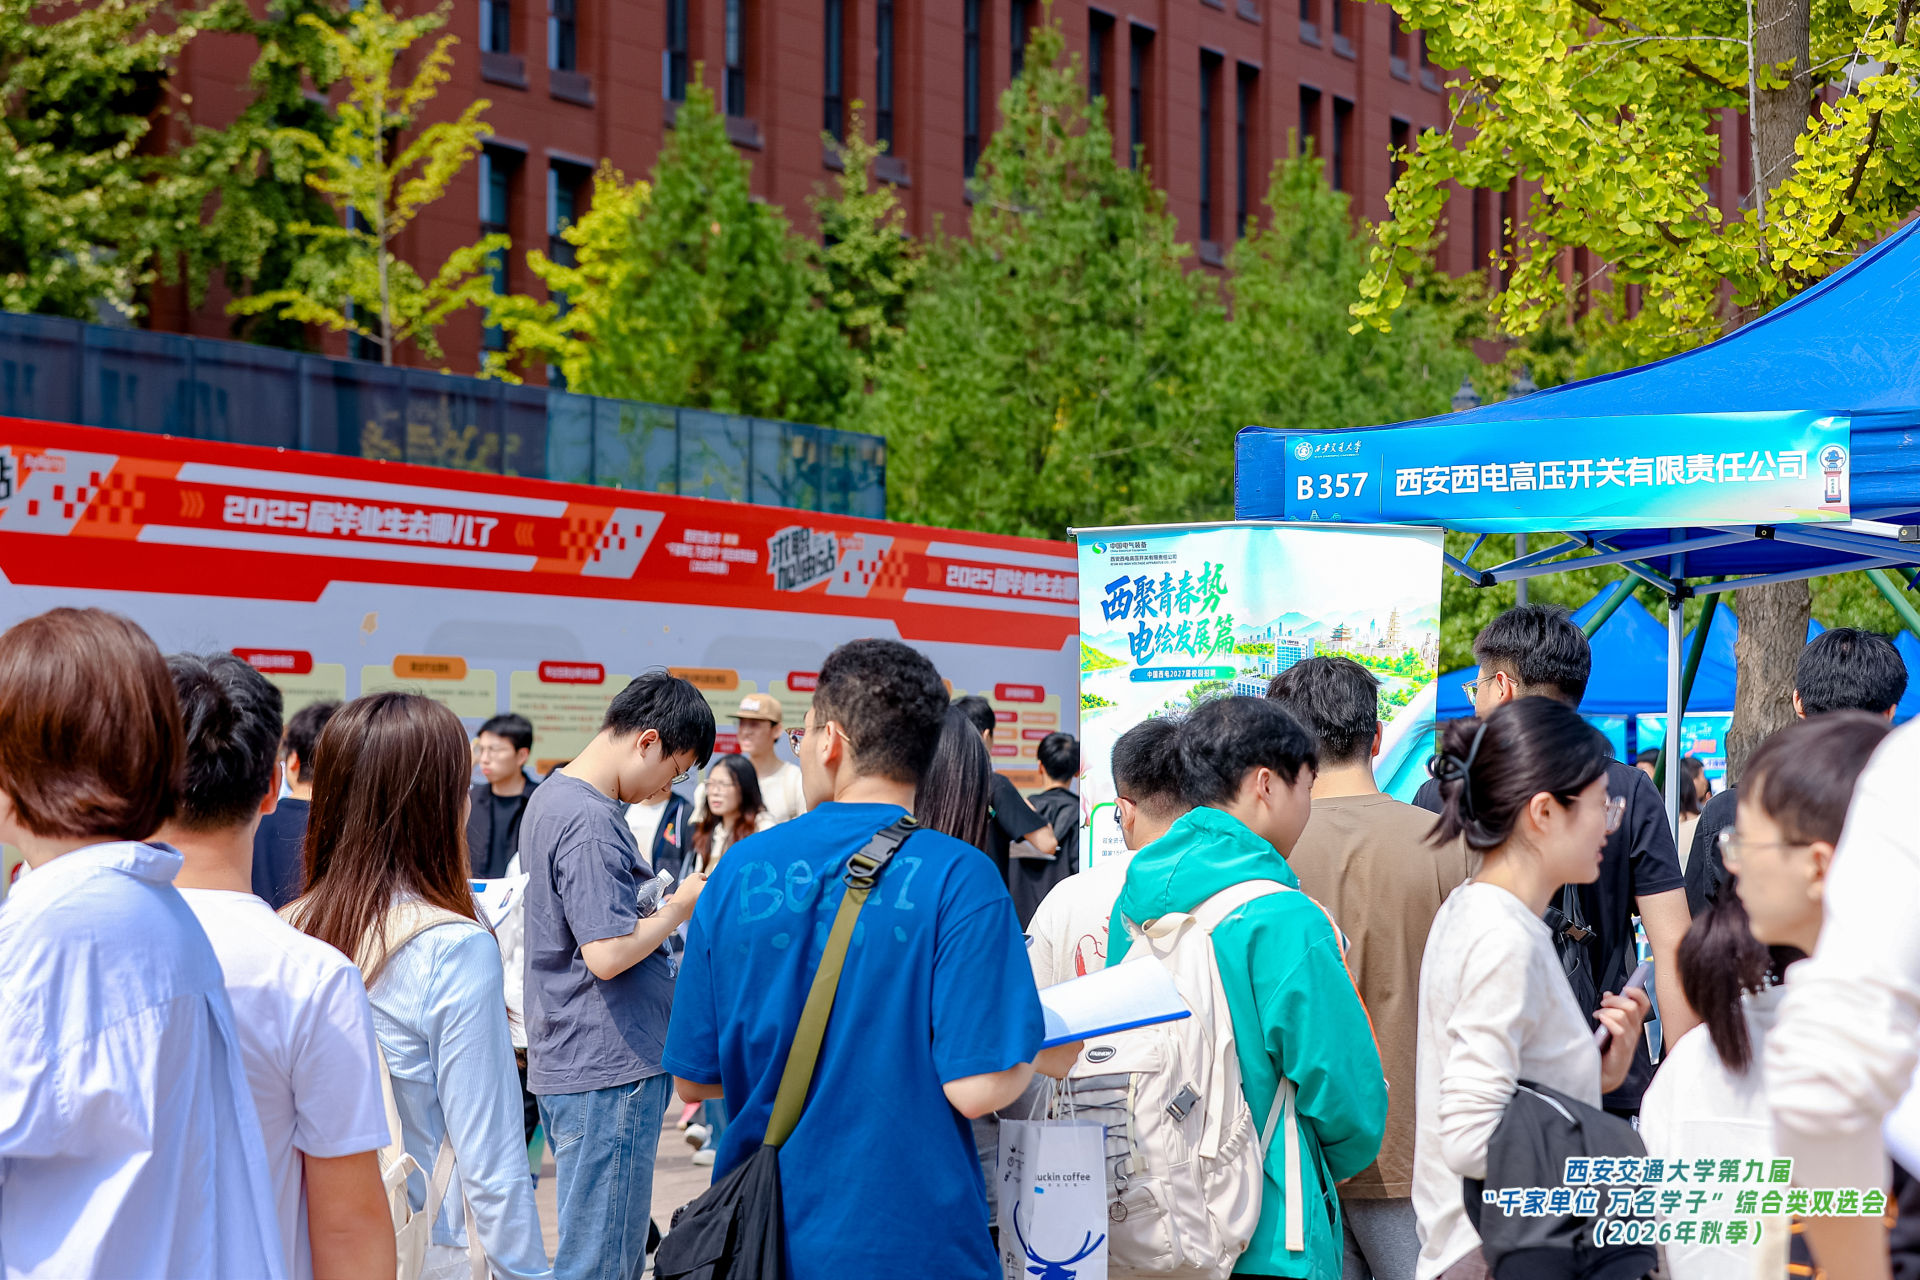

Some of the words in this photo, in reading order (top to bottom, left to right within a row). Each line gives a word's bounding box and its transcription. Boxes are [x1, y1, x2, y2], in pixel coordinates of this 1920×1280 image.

[1394, 450, 1808, 497] 西安西电高压开关有限责任公司
[222, 494, 500, 548] 2025届毕业生去哪儿了
[1101, 561, 1228, 624] 西聚青春势
[1128, 613, 1235, 667] 电绘发展篇
[1062, 1171, 1091, 1181] coffee
